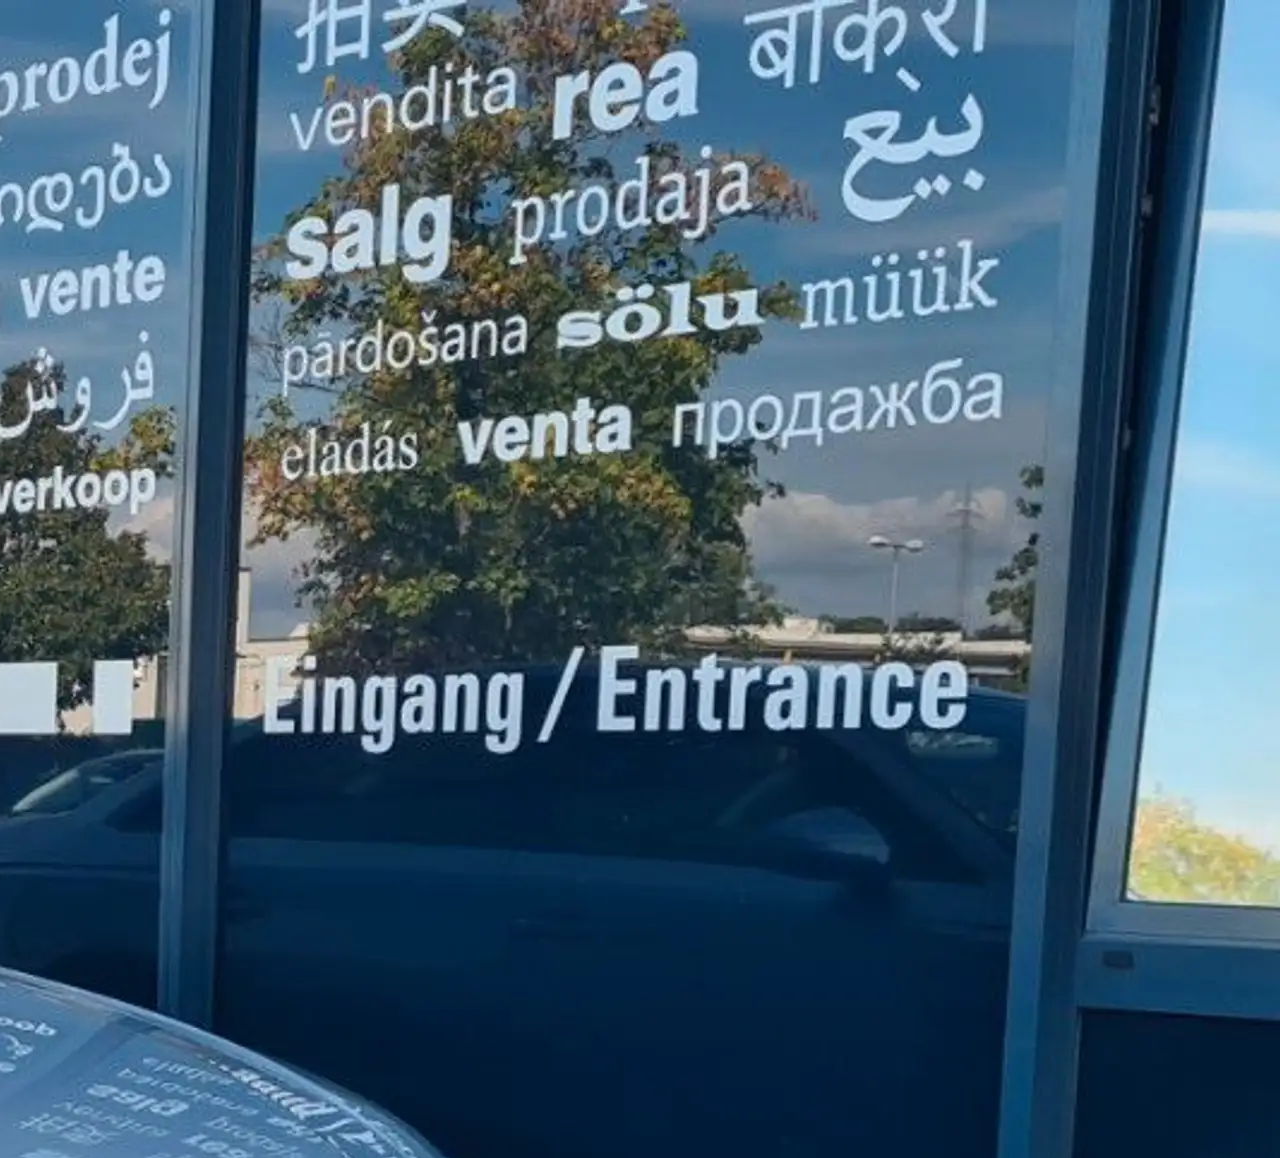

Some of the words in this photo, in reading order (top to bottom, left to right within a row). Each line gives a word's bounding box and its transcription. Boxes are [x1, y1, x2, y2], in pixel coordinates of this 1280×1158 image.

[289, 65, 516, 152] vendita
[553, 49, 698, 140] rea
[841, 92, 986, 223] بيع
[285, 183, 454, 284] salg
[509, 145, 752, 267] prodaja
[20, 249, 166, 319] vente
[282, 309, 529, 396] pārdošana
[555, 282, 766, 349] sölu
[799, 238, 1000, 330] müük
[281, 423, 419, 481] eladás
[458, 397, 633, 464] venta
[672, 357, 1004, 457] продажба
[262, 652, 526, 755] Eingang
[538, 645, 583, 744] /
[596, 645, 970, 733] Entrance
